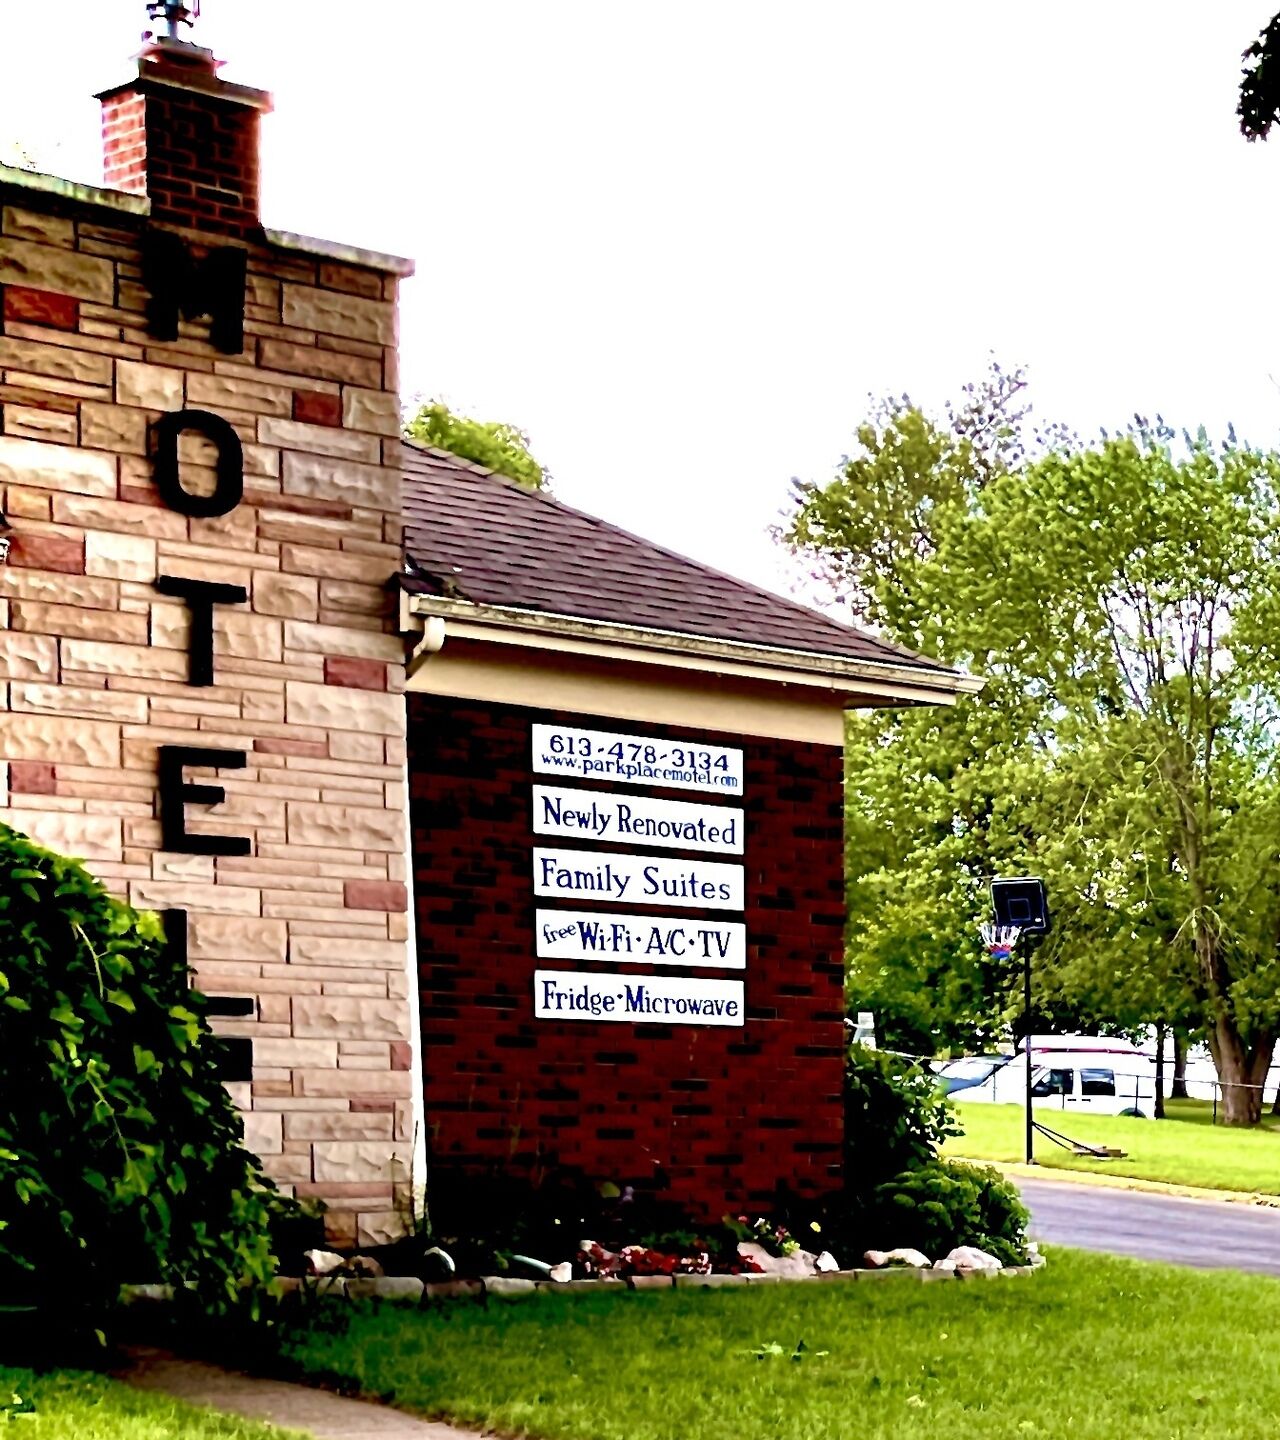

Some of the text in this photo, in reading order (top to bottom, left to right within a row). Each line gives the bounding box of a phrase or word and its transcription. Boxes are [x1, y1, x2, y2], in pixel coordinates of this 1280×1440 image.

[541, 753, 738, 788] www.parkplacemotel.com
[550, 734, 729, 772] 613-478-3134
[541, 795, 736, 846] Newly Renovated
[541, 857, 731, 901] Family Suites
[543, 923, 577, 945] free
[697, 929, 732, 958] TV
[541, 980, 739, 1017] Fridge Microwave
